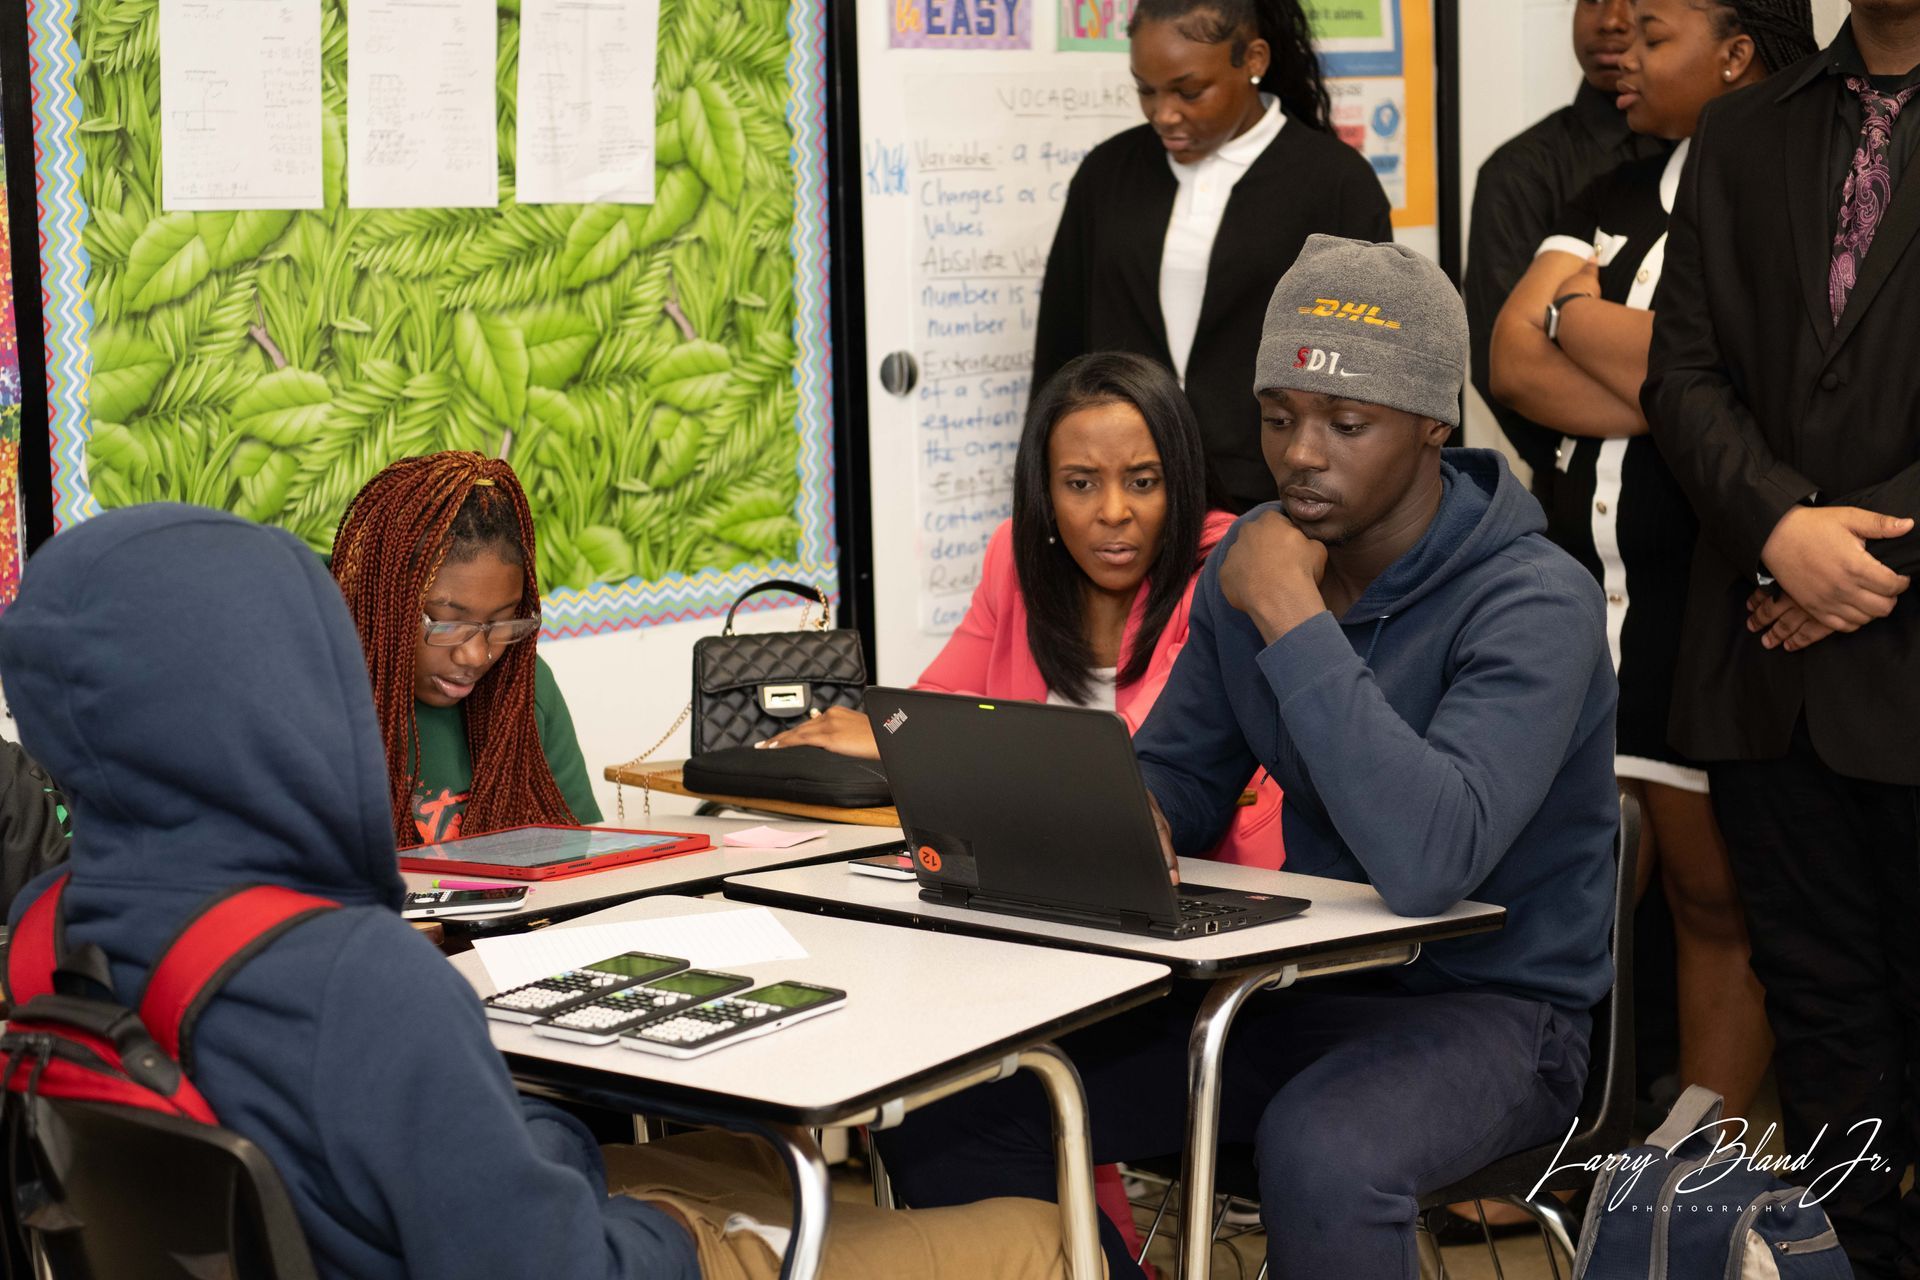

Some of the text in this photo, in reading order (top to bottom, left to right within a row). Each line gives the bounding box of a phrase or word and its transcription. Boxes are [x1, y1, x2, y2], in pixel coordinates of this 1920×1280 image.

[926, 0, 1022, 37] EASY
[996, 84, 1134, 111] VOCABULAR
[921, 178, 1005, 215] Changes
[1310, 298, 1387, 327] DHL
[922, 851, 937, 867] 12
